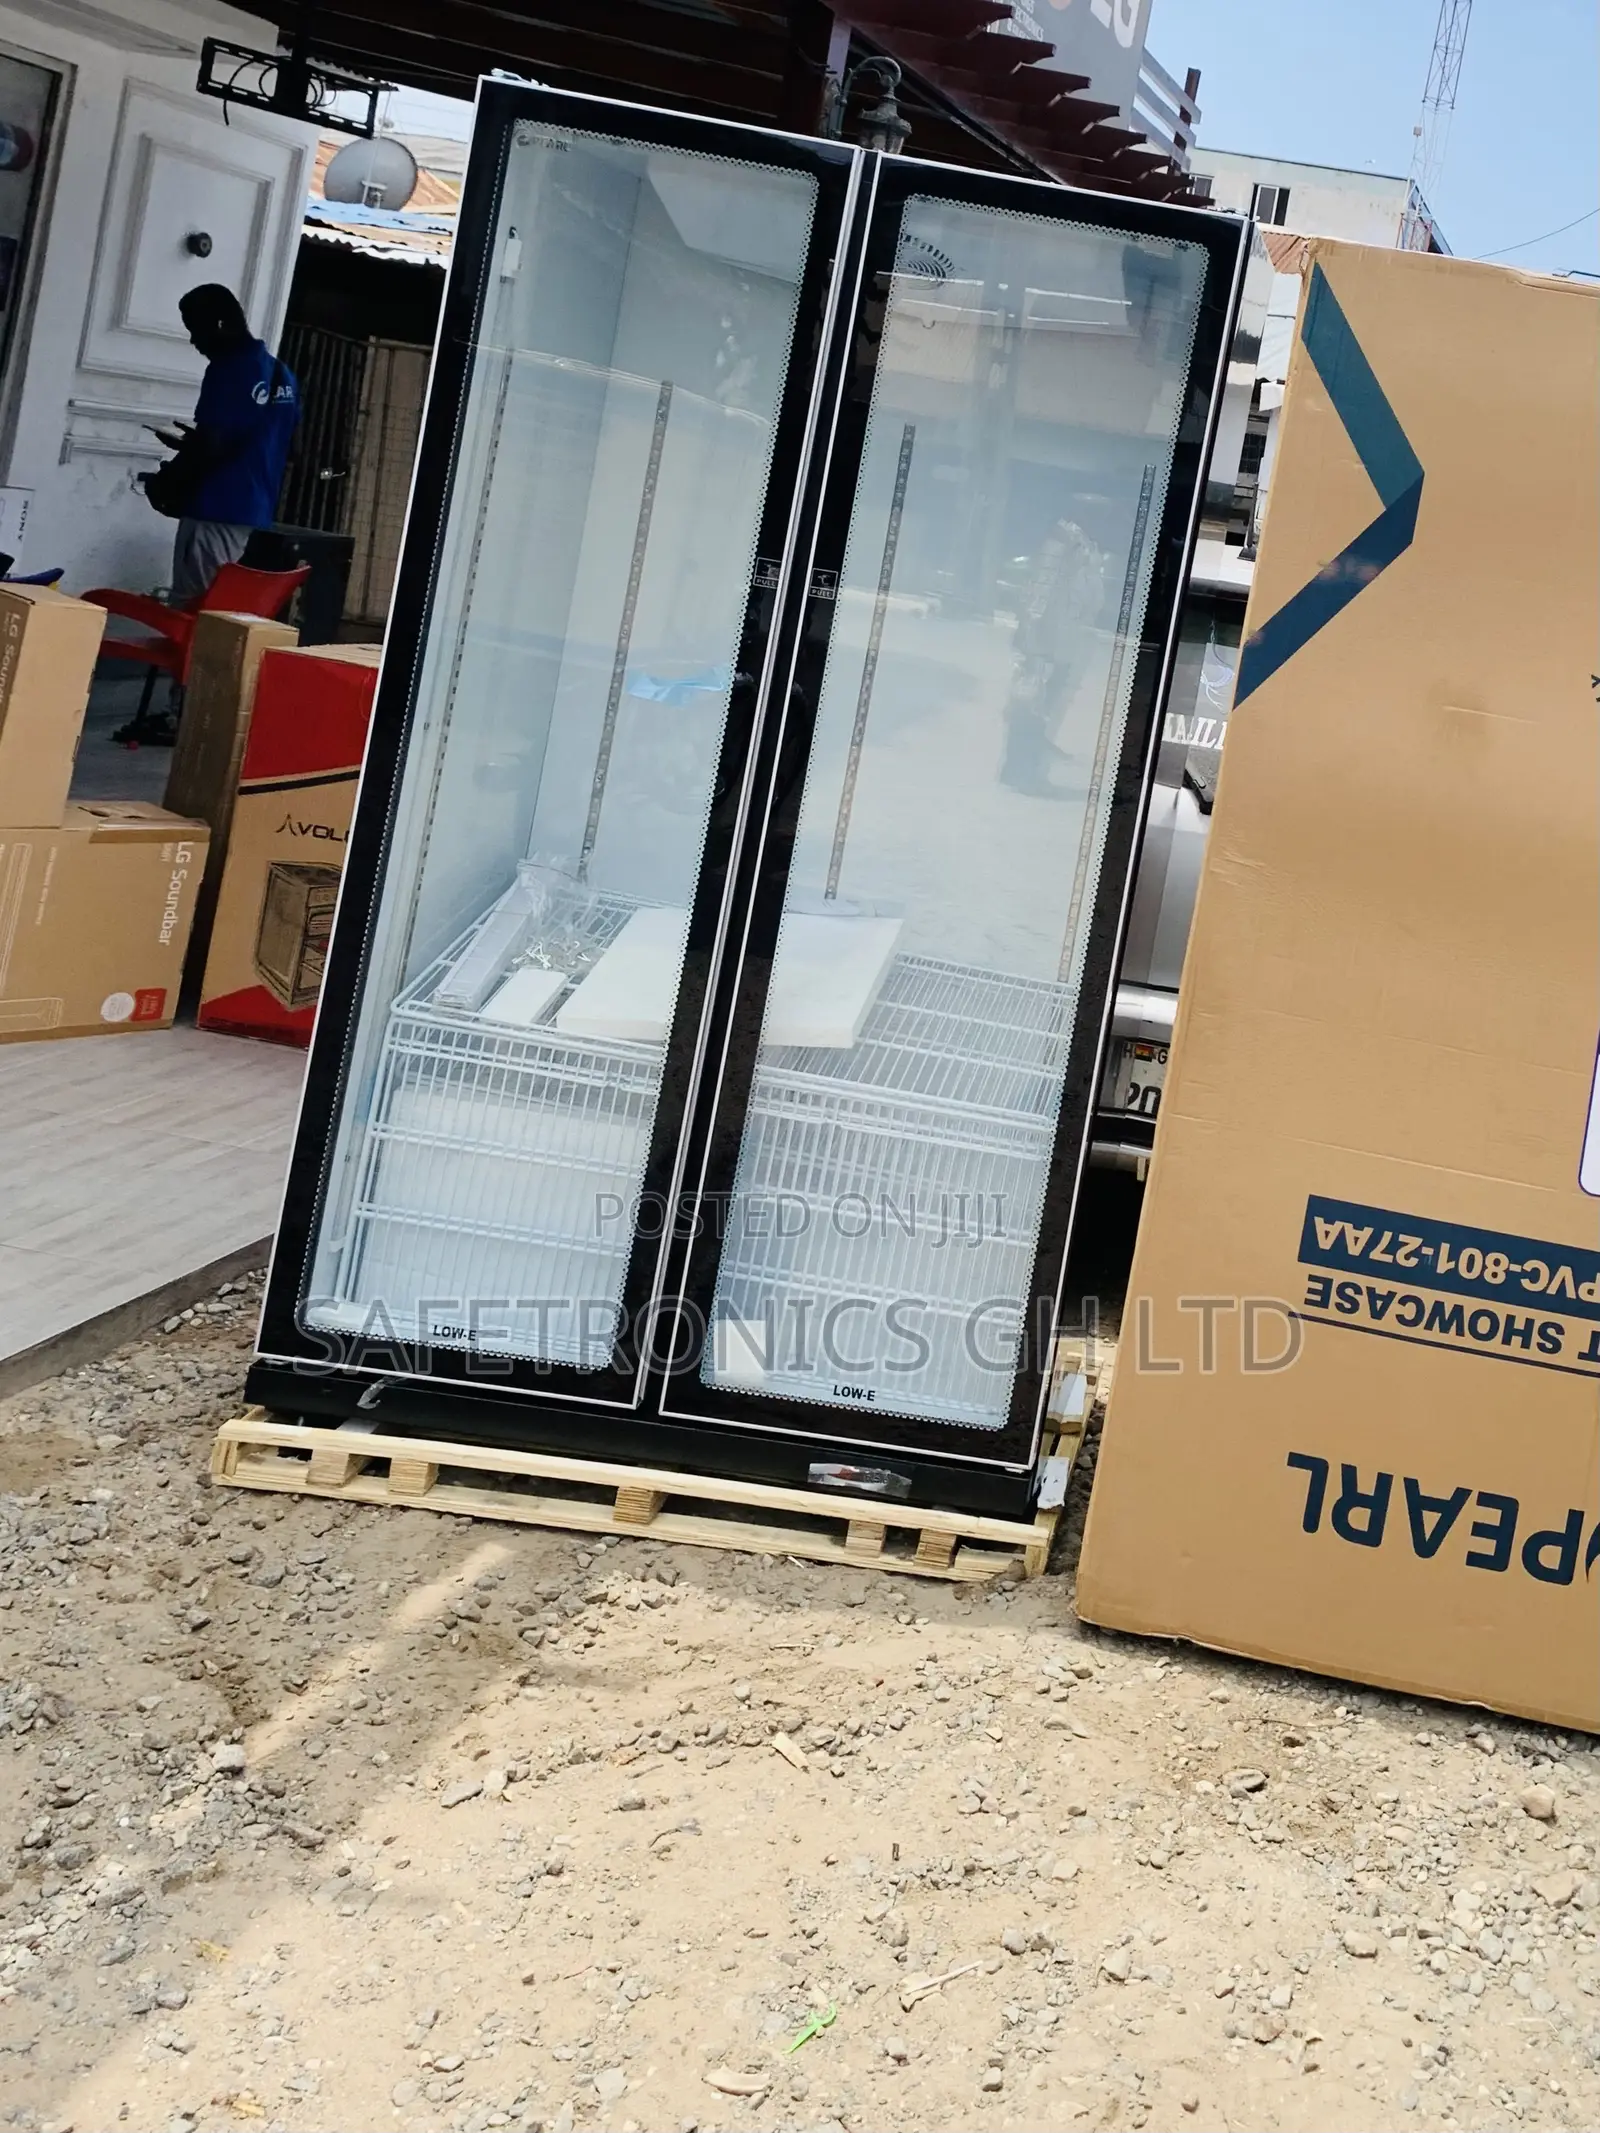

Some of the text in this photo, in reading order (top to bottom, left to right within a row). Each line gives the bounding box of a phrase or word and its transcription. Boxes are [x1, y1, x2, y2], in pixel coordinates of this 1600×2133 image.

[18, 500, 29, 541] SONY
[756, 578, 777, 588] PULL
[811, 589, 832, 598] PULL
[9, 613, 21, 638] LG
[175, 841, 194, 864] LG
[159, 868, 188, 946] Soundbar
[1303, 1273, 1566, 1355] SHOWCASE
[432, 1324, 477, 1342] LOW-E
[832, 1384, 876, 1402] LOW-E
[1286, 1451, 1585, 1587] PEARL
